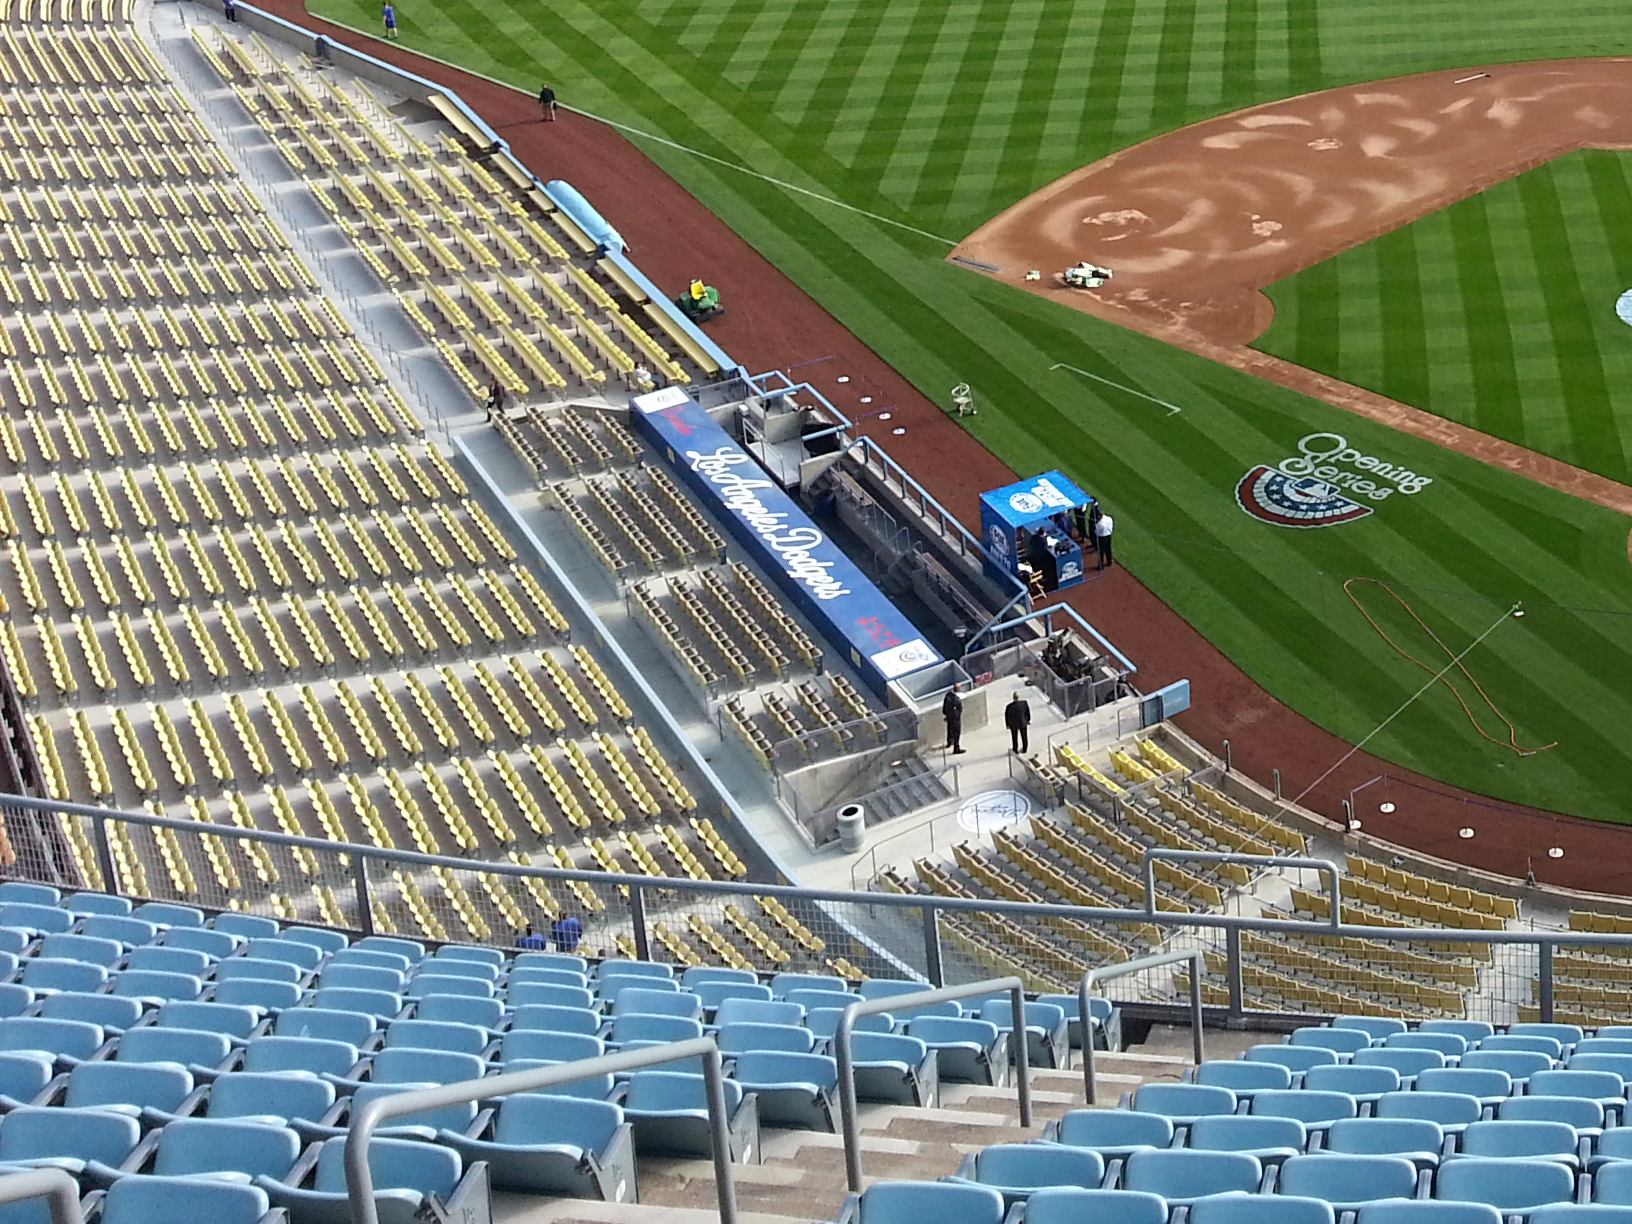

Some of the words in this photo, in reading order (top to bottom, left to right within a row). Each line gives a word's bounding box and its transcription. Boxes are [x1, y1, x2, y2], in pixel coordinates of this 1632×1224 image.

[686, 446, 748, 476] Los
[1279, 453, 1394, 500] Series
[1298, 432, 1433, 494] Opening
[710, 473, 790, 536] Angeles
[762, 527, 851, 600] Dodgers
